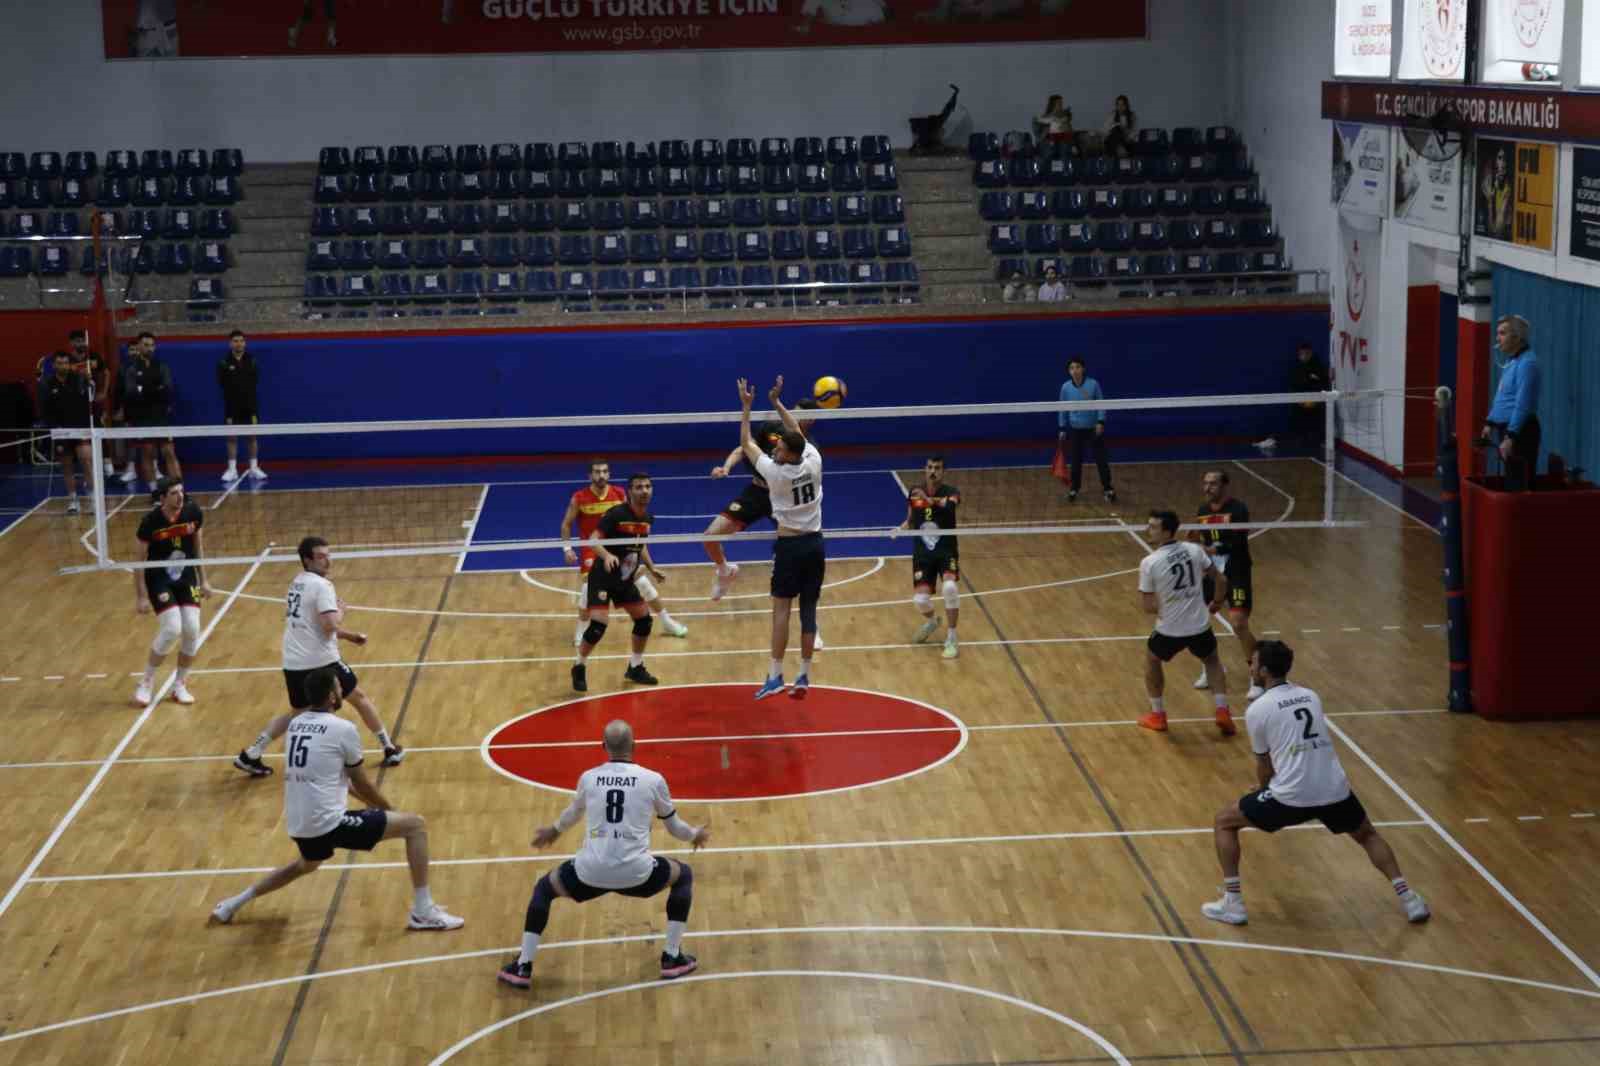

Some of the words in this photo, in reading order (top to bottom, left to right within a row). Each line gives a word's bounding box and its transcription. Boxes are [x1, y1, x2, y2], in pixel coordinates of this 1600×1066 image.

[562, 20, 702, 44] www.gsb.gov.tr
[1375, 93, 1391, 115] T.C.
[1456, 99, 1485, 123] SPOR
[1488, 97, 1560, 129] BAKANLIĞI
[792, 483, 815, 505] 18
[1171, 559, 1195, 590] 21
[1294, 707, 1319, 740] 2
[288, 735, 312, 768] 15
[596, 776, 638, 787] MURAT
[606, 789, 625, 823] 8
